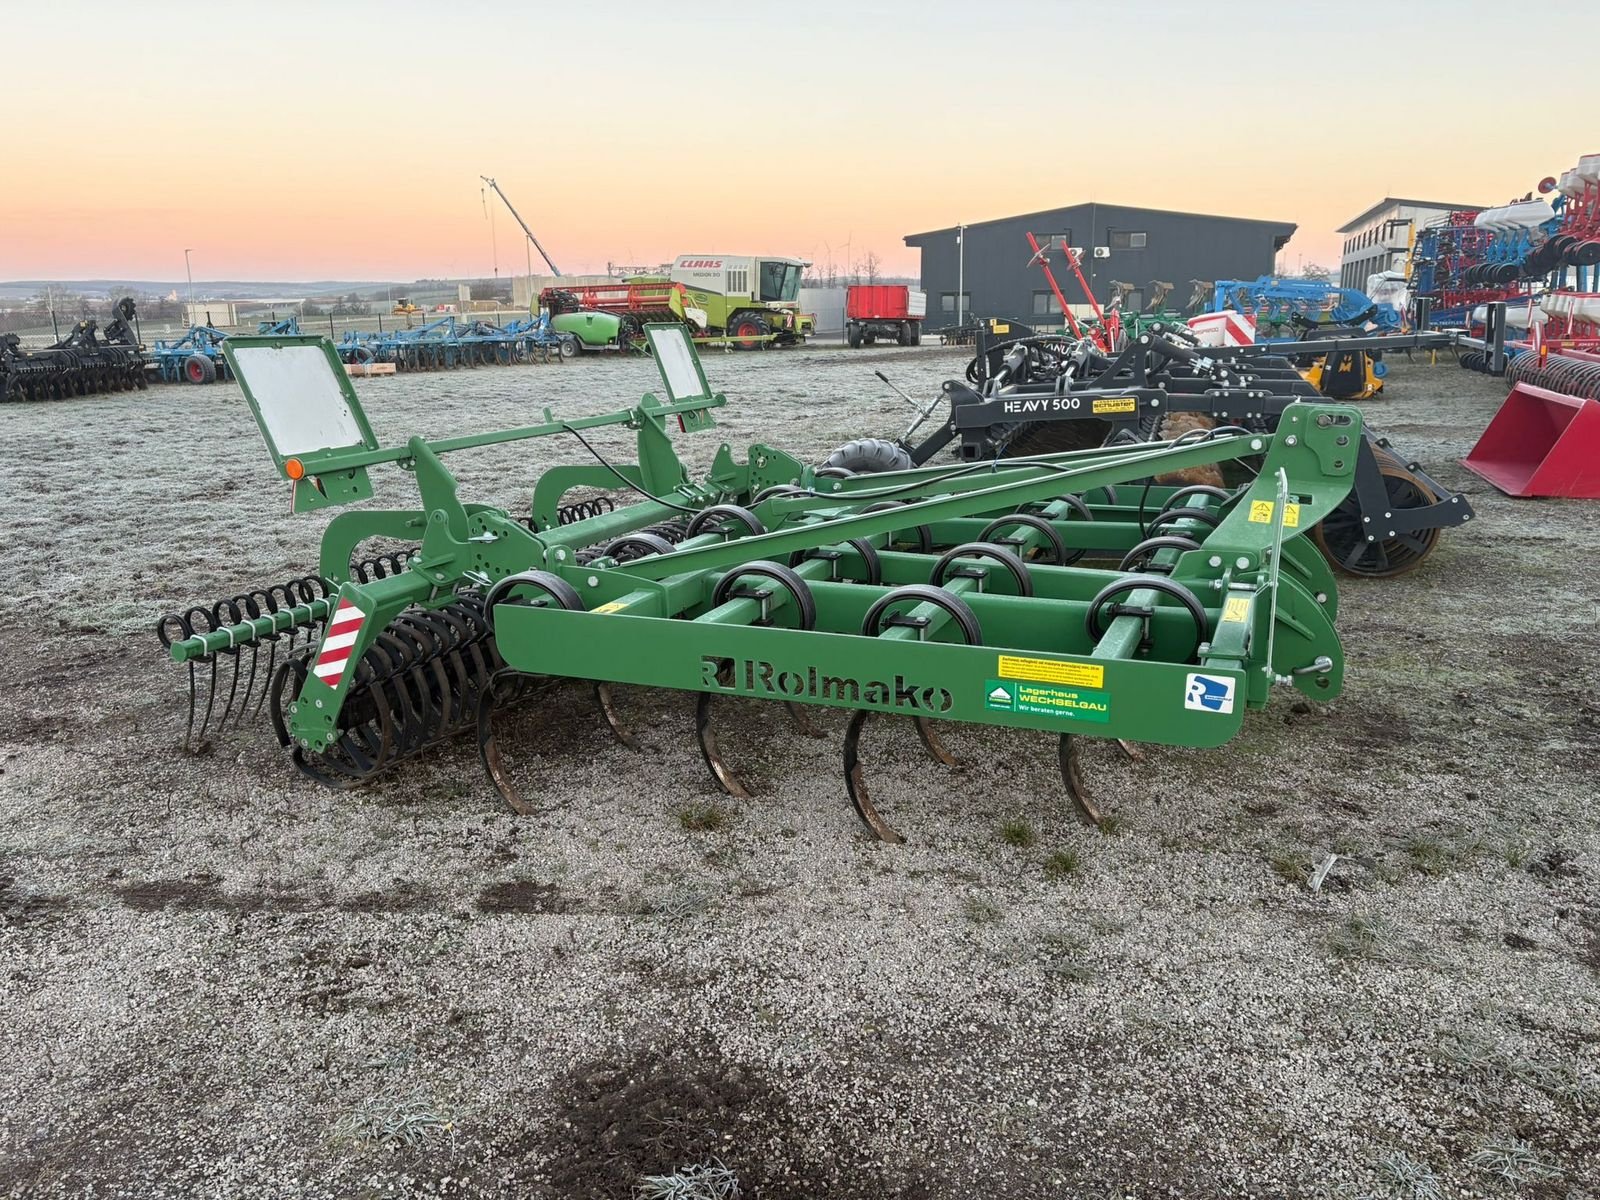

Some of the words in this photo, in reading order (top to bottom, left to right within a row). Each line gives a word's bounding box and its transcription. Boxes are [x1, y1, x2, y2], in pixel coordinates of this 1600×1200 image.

[680, 260, 723, 268] CLAAS
[1004, 400, 1049, 413] HEAVY
[1052, 398, 1081, 411] 500
[742, 659, 954, 713] Rolmako
[1019, 685, 1078, 699] Lagerhaus
[1019, 694, 1107, 711] WECHSELGAU
[1030, 705, 1055, 714] beraten
[1055, 709, 1075, 717] gerne.
